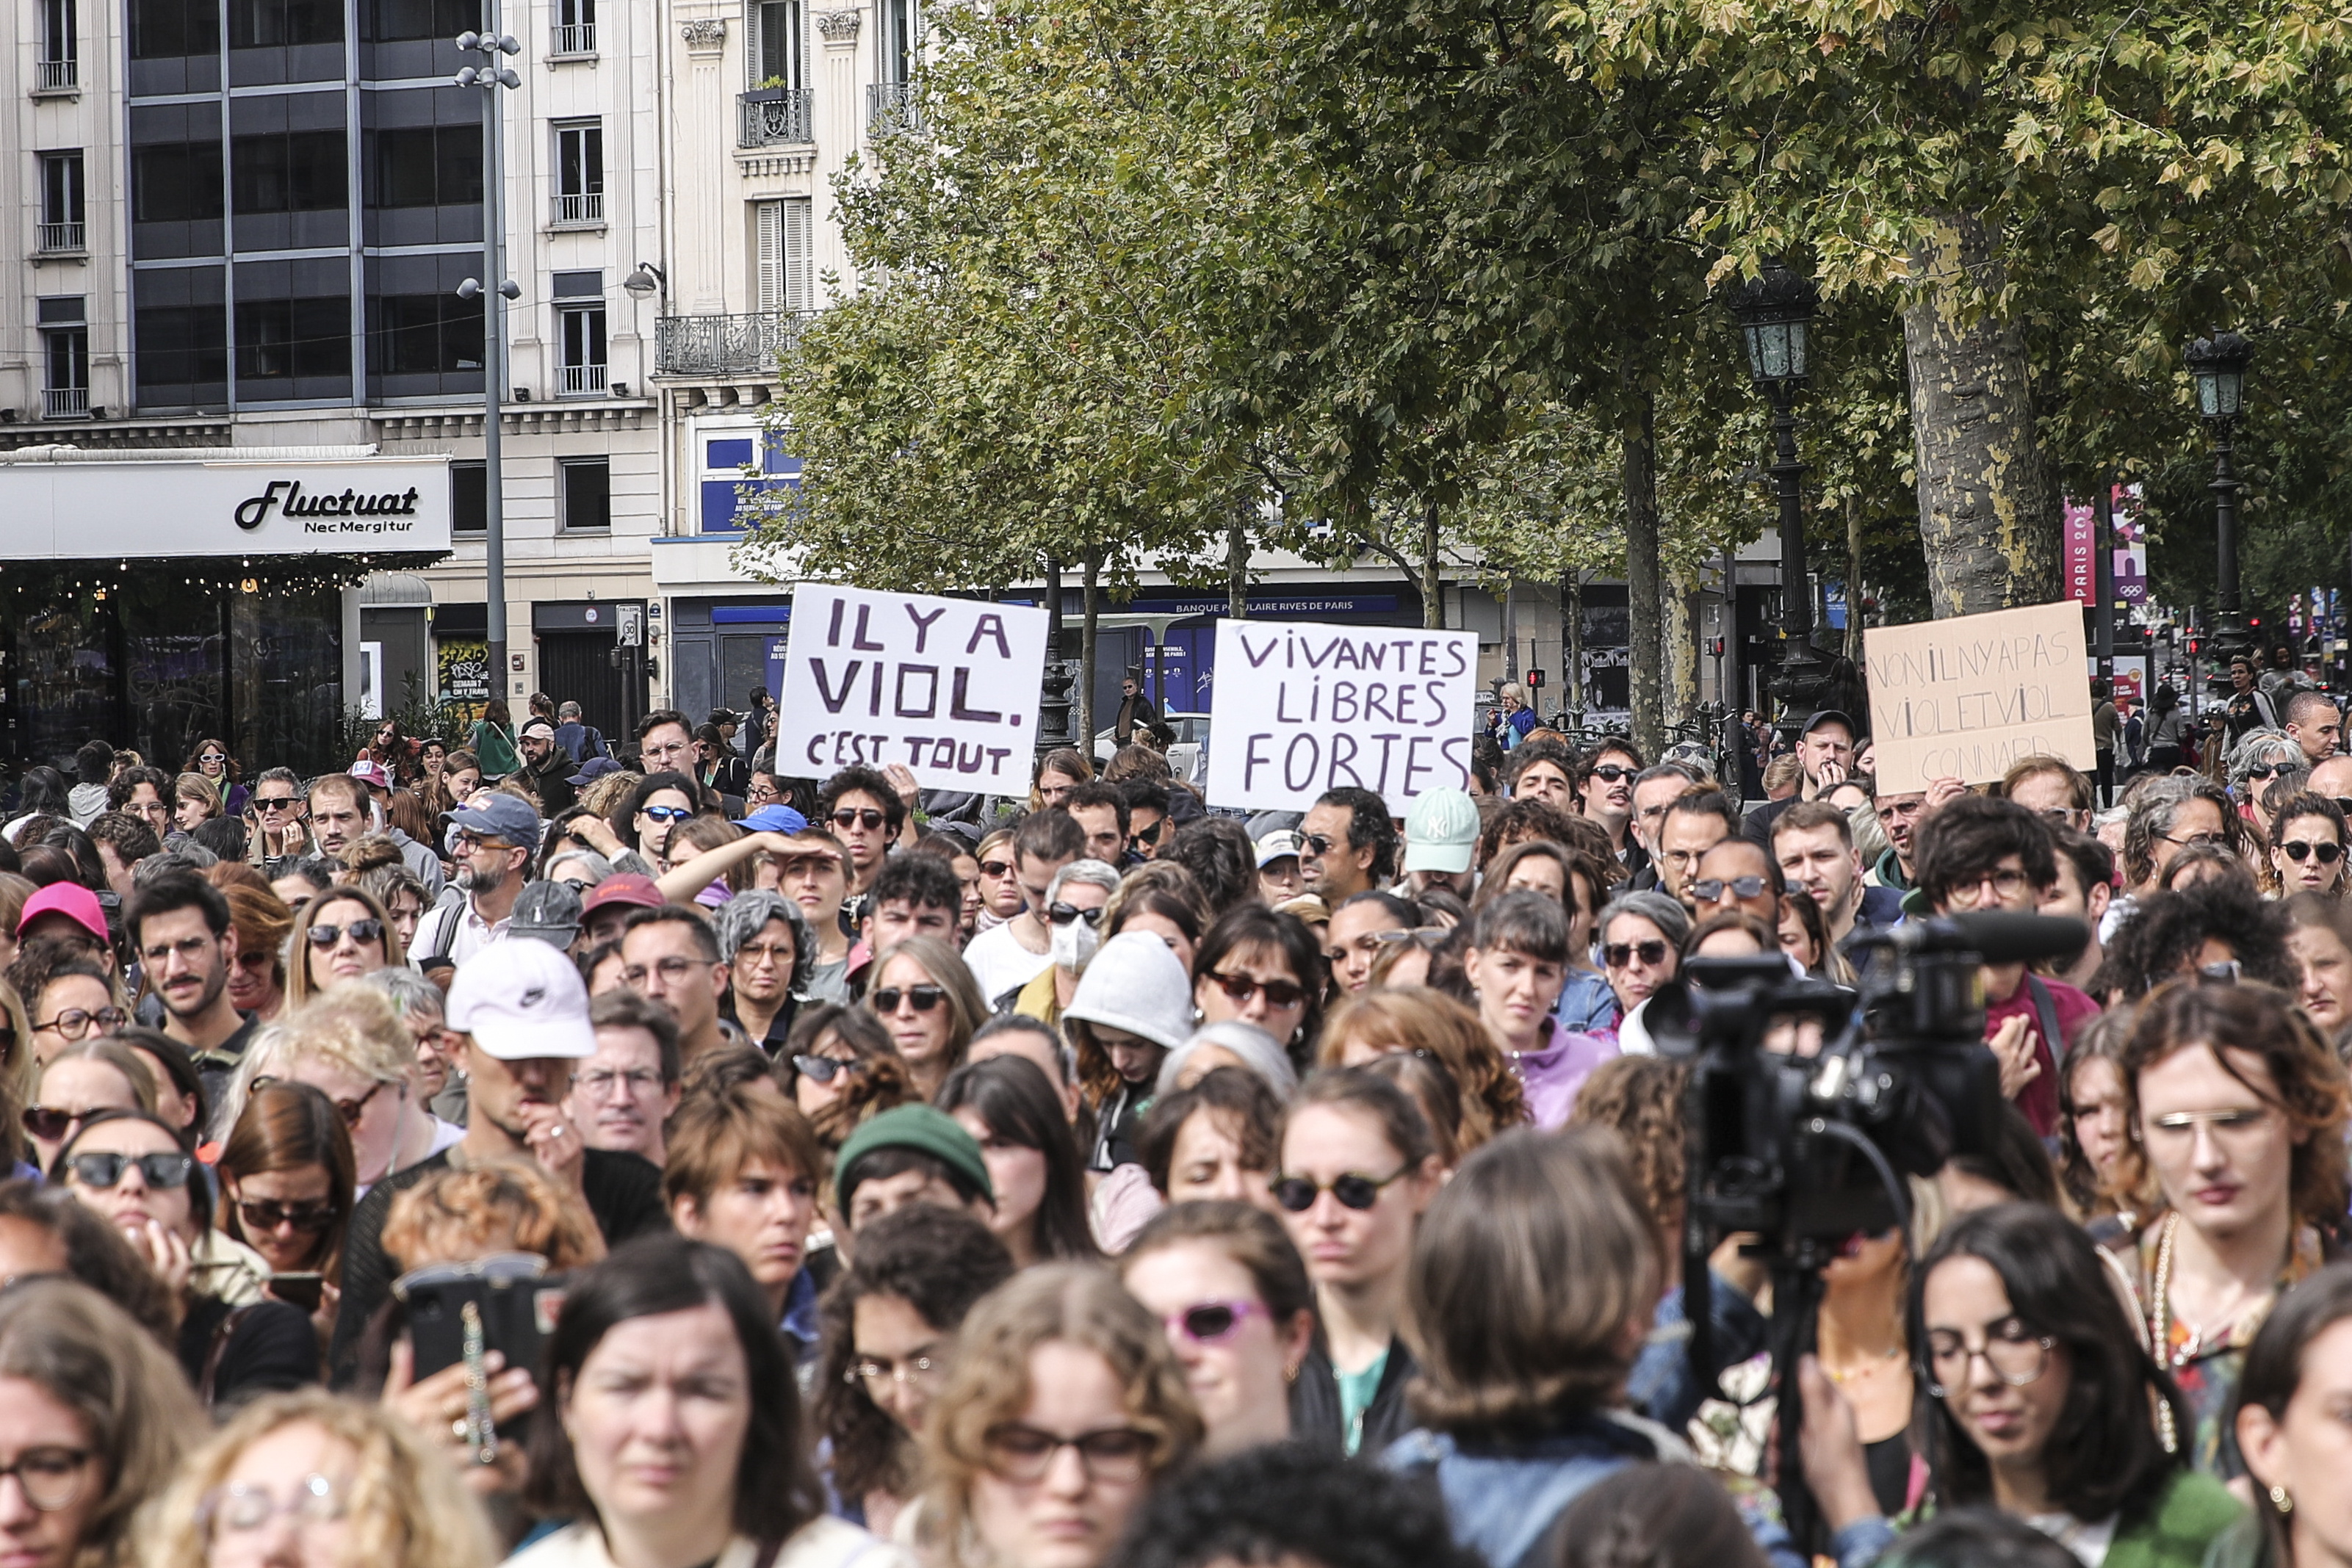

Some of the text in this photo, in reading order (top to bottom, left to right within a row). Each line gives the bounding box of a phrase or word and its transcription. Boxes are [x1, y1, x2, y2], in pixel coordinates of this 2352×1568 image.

[234, 480, 419, 529] Fluctuat
[304, 521, 413, 533] Nec Mergitur
[2074, 504, 2087, 597] PARIS 202
[625, 626, 635, 634] 30
[827, 598, 1011, 659] IL Y A
[1176, 604, 1219, 613] BANQUE
[1280, 602, 1307, 610] RIVES
[1325, 601, 1353, 610] PARIS
[809, 657, 1022, 726] VIOL.
[807, 731, 1011, 775] C'EST TOUT
[1244, 732, 1470, 797] FORTES
